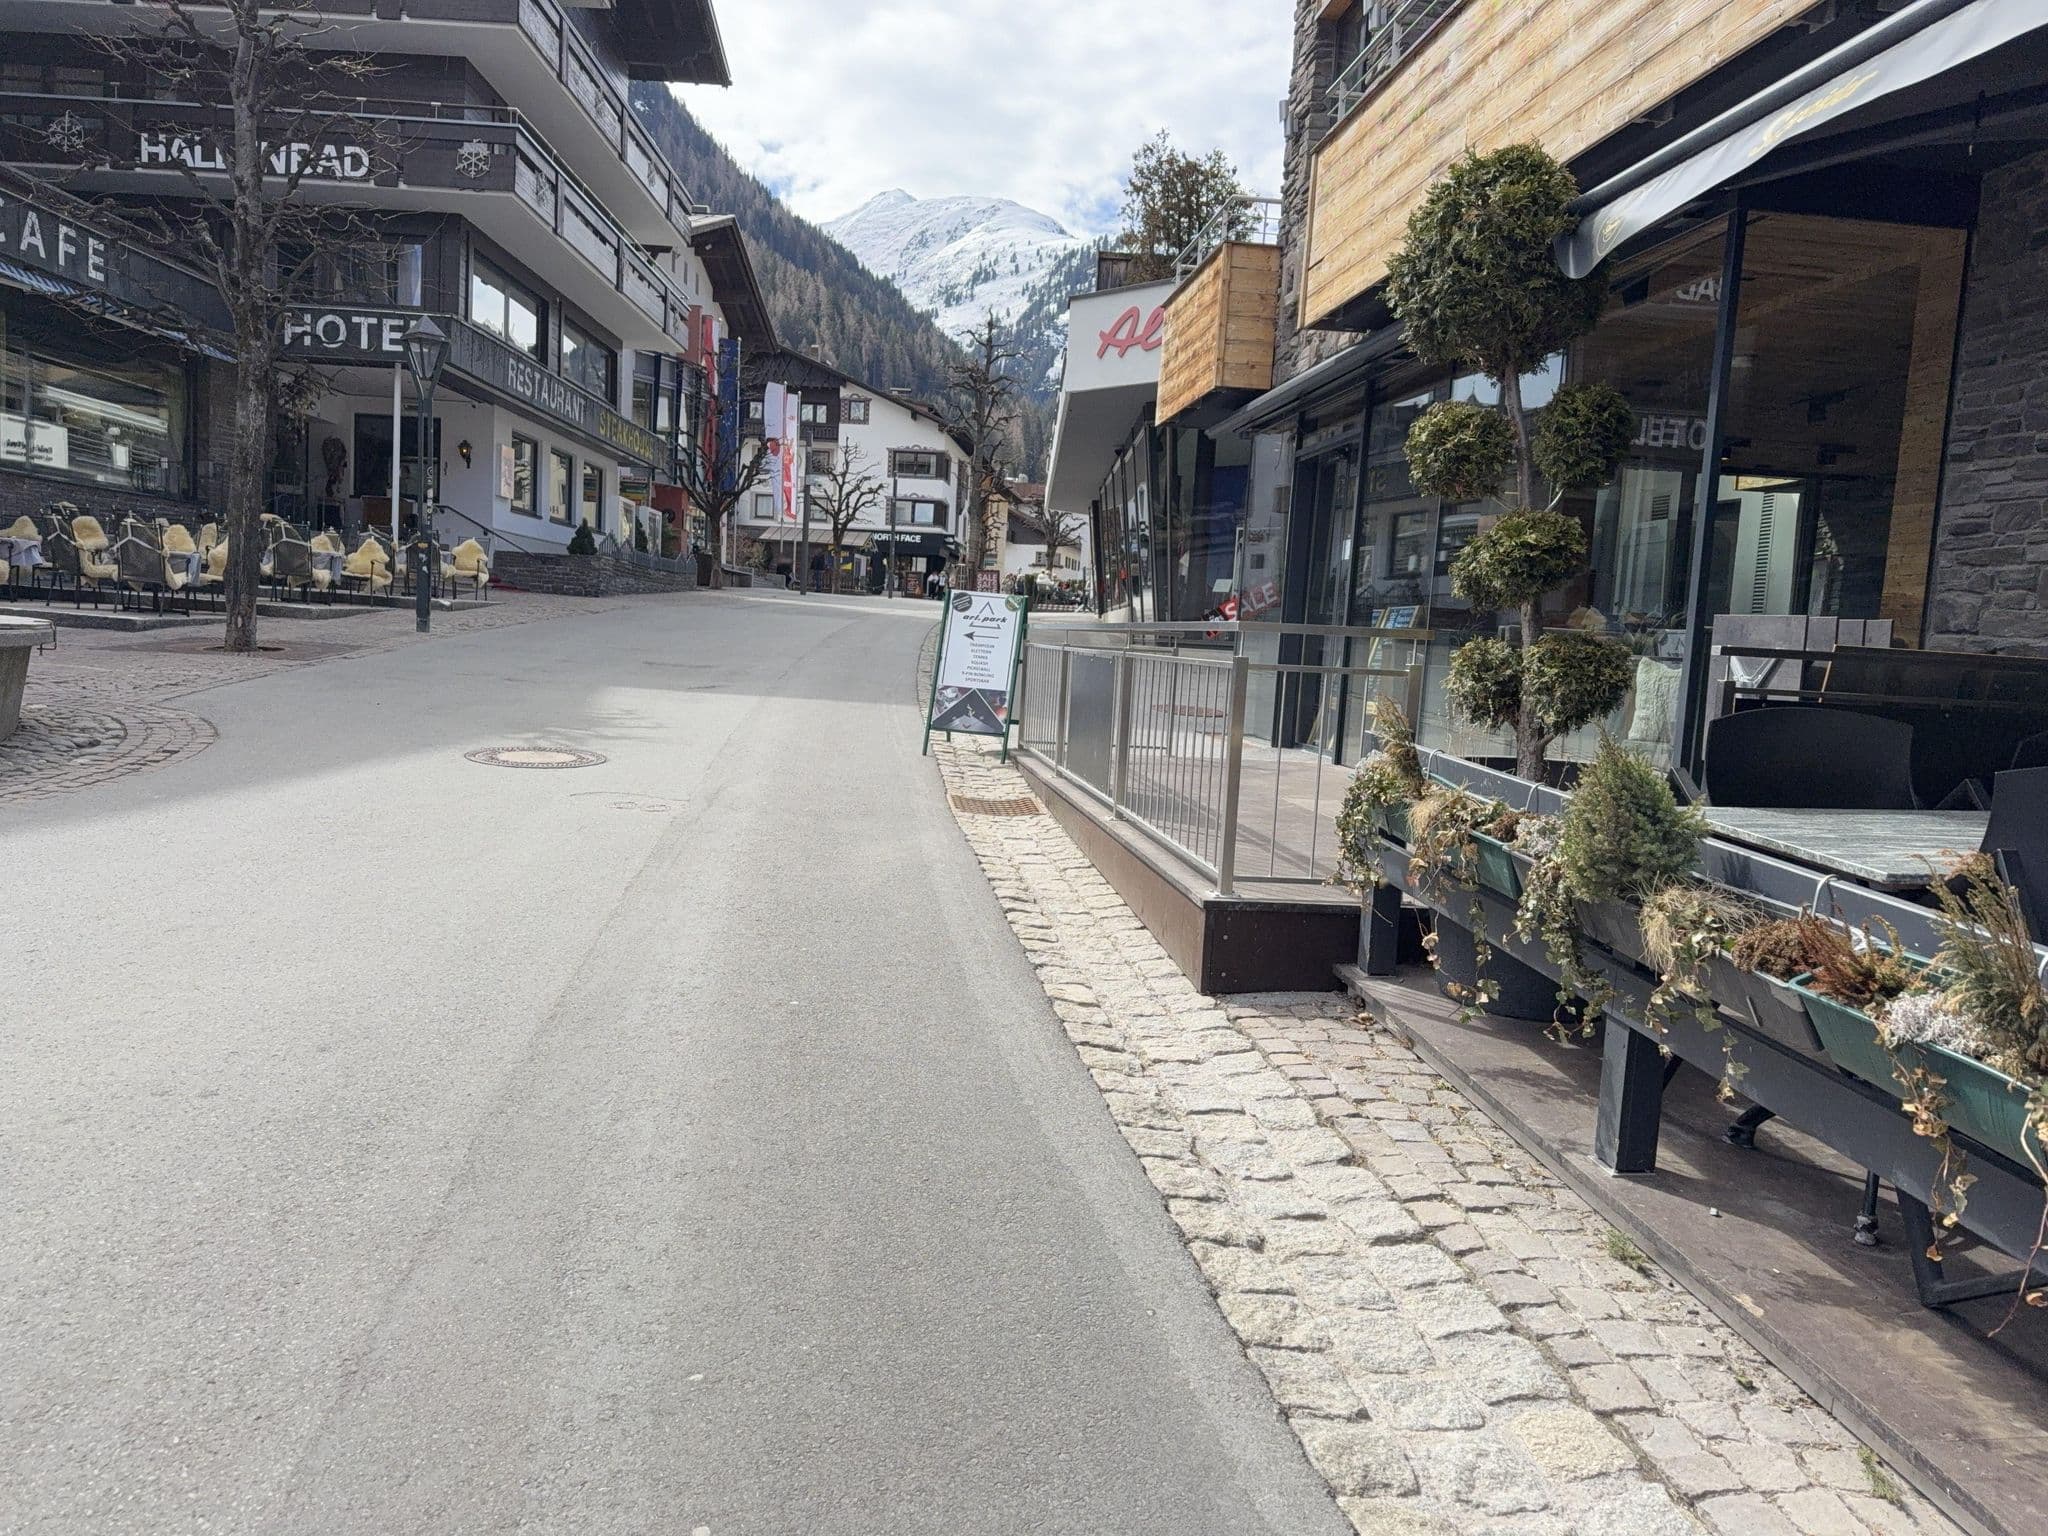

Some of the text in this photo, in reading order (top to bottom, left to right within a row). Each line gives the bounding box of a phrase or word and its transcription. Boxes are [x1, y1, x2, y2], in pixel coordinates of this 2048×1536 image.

[0, 197, 105, 282] AFE
[507, 357, 586, 425] RESTAURANT
[900, 534, 921, 543] FACE
